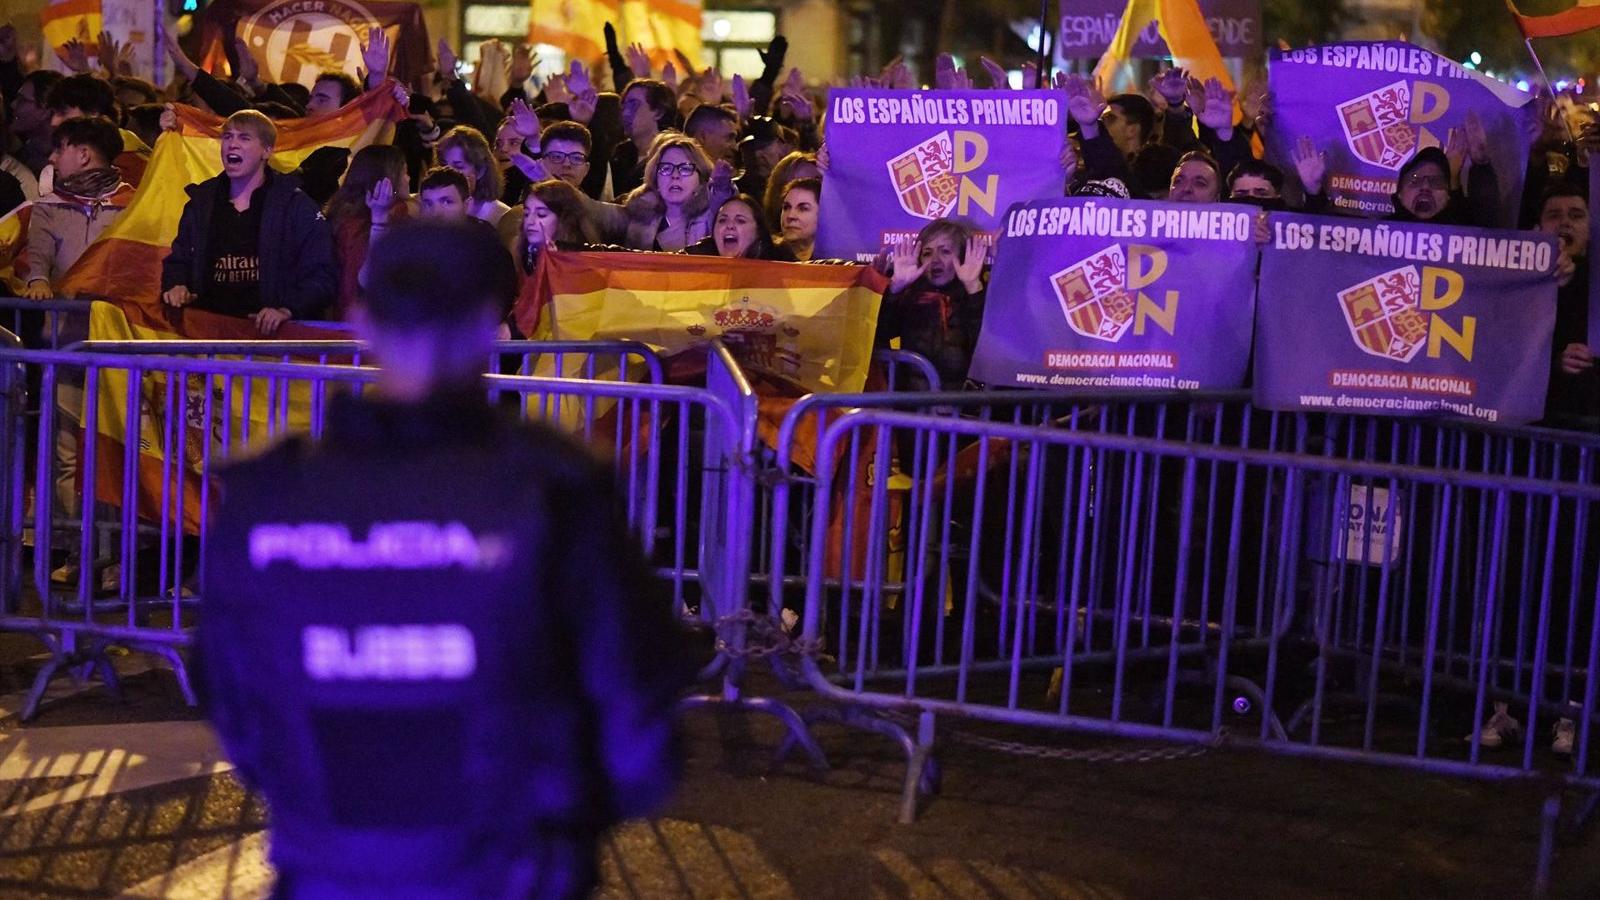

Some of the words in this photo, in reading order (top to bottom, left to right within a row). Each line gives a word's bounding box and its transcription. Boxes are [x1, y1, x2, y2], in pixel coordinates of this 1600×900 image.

[269, 1, 324, 23] HACER
[1061, 13, 1117, 46] ESPAÑ
[1322, 43, 1433, 76] ESPAÑOLES
[833, 97, 866, 124] LOS
[868, 94, 969, 125] ESPAÑOLES
[971, 99, 1058, 126] PRIMERO
[1007, 209, 1038, 238] LOS
[1038, 201, 1147, 238] ESPAÑOLES
[1151, 210, 1250, 242] PRIMERO
[1275, 221, 1314, 250] LOS
[1319, 225, 1442, 262] ESPAÑOLES
[1447, 235, 1551, 272] PRIMERO
[1048, 353, 1116, 368] DEMOCRACIA
[1118, 354, 1174, 369] NACIONAL
[1333, 372, 1408, 390] DEMOCRACIA
[1411, 377, 1472, 395] NACIONAL
